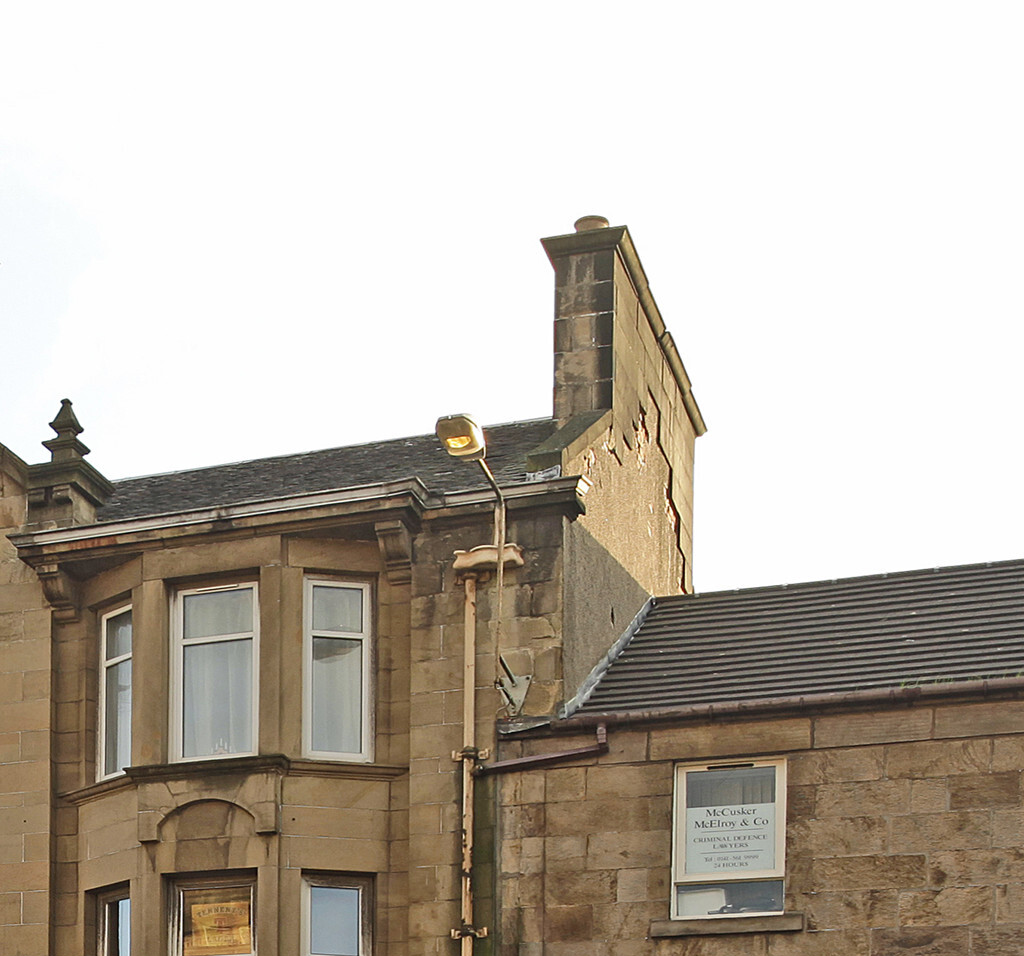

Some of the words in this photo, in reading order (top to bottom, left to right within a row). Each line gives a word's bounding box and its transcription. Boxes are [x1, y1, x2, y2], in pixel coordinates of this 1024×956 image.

[705, 807, 757, 817] McCusker
[694, 820, 736, 829] McElroy
[740, 819, 749, 827] &
[753, 817, 769, 826] Co
